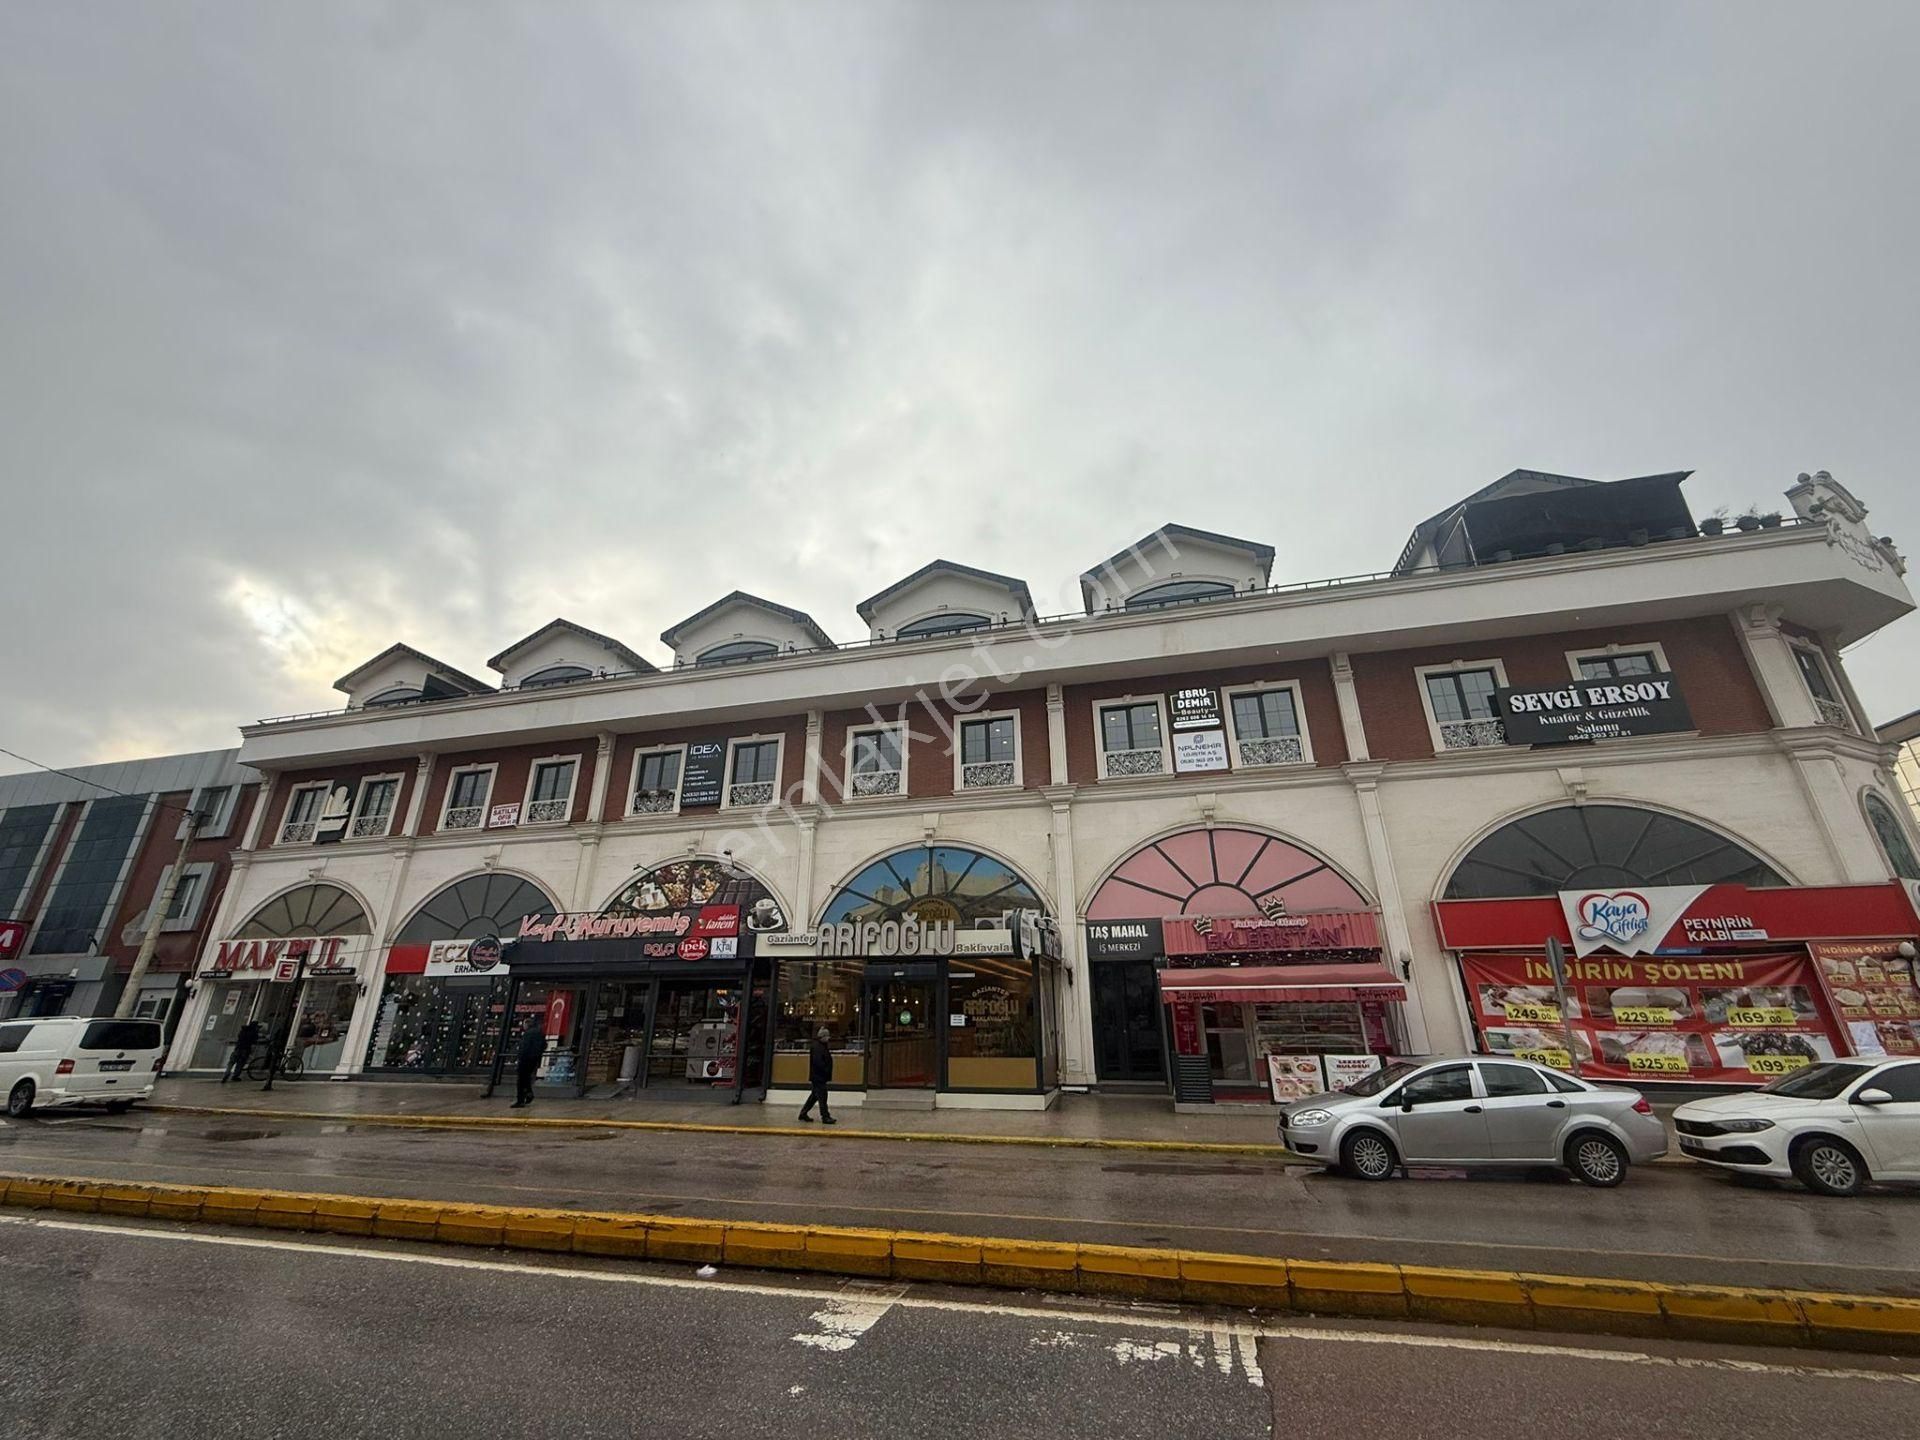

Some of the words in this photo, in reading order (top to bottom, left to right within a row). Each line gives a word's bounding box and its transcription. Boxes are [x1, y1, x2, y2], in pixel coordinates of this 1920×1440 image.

[1178, 688, 1207, 699] EBRU
[1509, 684, 1583, 713] SEVGİ
[1586, 680, 1671, 706] ERSOY
[1180, 708, 1209, 716] Beauty
[1538, 711, 1582, 726] Kuaför
[1584, 712, 1596, 722] &
[1576, 720, 1620, 734] Salonu
[1591, 900, 1638, 924] Kaya
[578, 911, 691, 937] Kuruyemiş
[1683, 915, 1754, 931] PEYNİRİN
[766, 934, 817, 946] Gaziantep
[816, 911, 955, 957] ARİFOĞLU
[1089, 926, 1109, 940] TAŞ
[1111, 924, 1149, 938] MAHAL
[430, 943, 470, 964] ECZ
[681, 940, 707, 953] ipek
[1107, 940, 1141, 953] MERKEZİ
[1645, 958, 1745, 984] ŞÖLENİ
